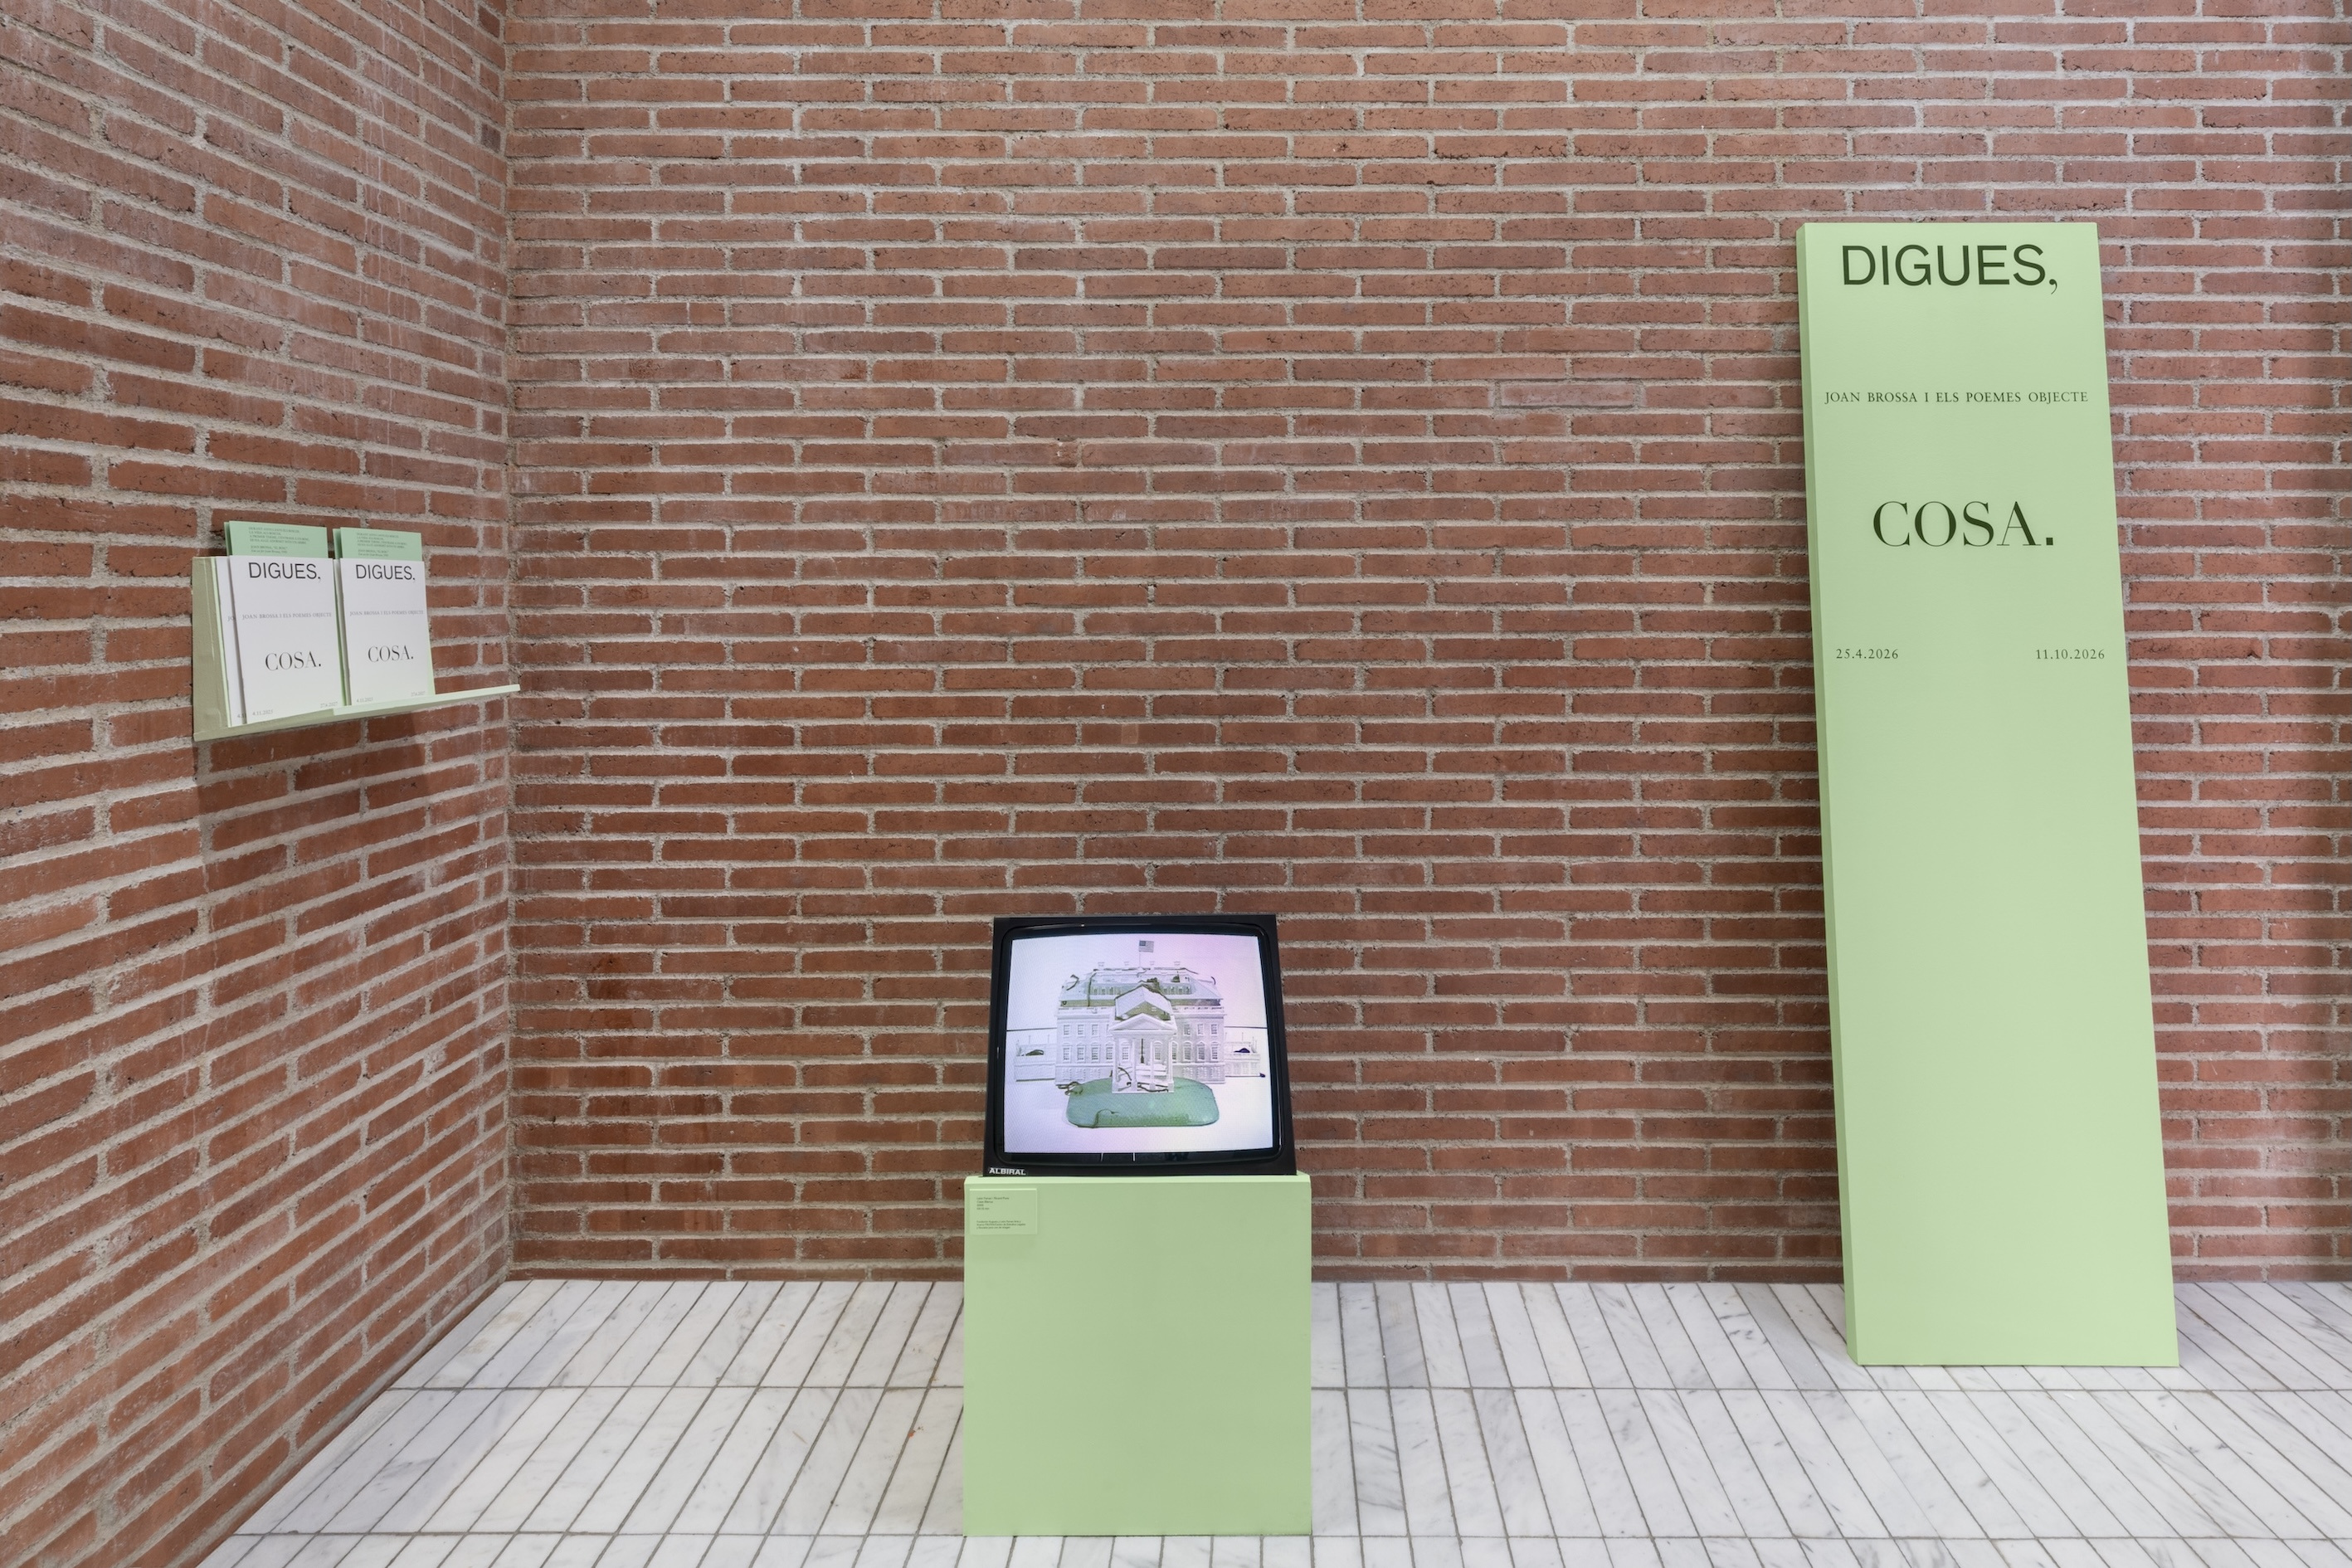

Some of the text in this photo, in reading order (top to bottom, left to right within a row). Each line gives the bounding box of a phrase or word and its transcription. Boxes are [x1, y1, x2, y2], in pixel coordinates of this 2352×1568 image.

[1842, 244, 2057, 295] DIGUES,
[1824, 392, 2089, 404] JOAN BROSSA I ELS POEMES OBJECTE
[1872, 500, 2054, 547] COSA.
[248, 562, 322, 582] DIGUES,
[355, 564, 416, 582] DIGUES,
[265, 650, 322, 671] COSA.
[368, 645, 414, 663] COSA.
[1835, 648, 1900, 660] 25.4.2026
[2035, 648, 2106, 660] 11.10.2026
[989, 1167, 1026, 1176] ALBIRAL
